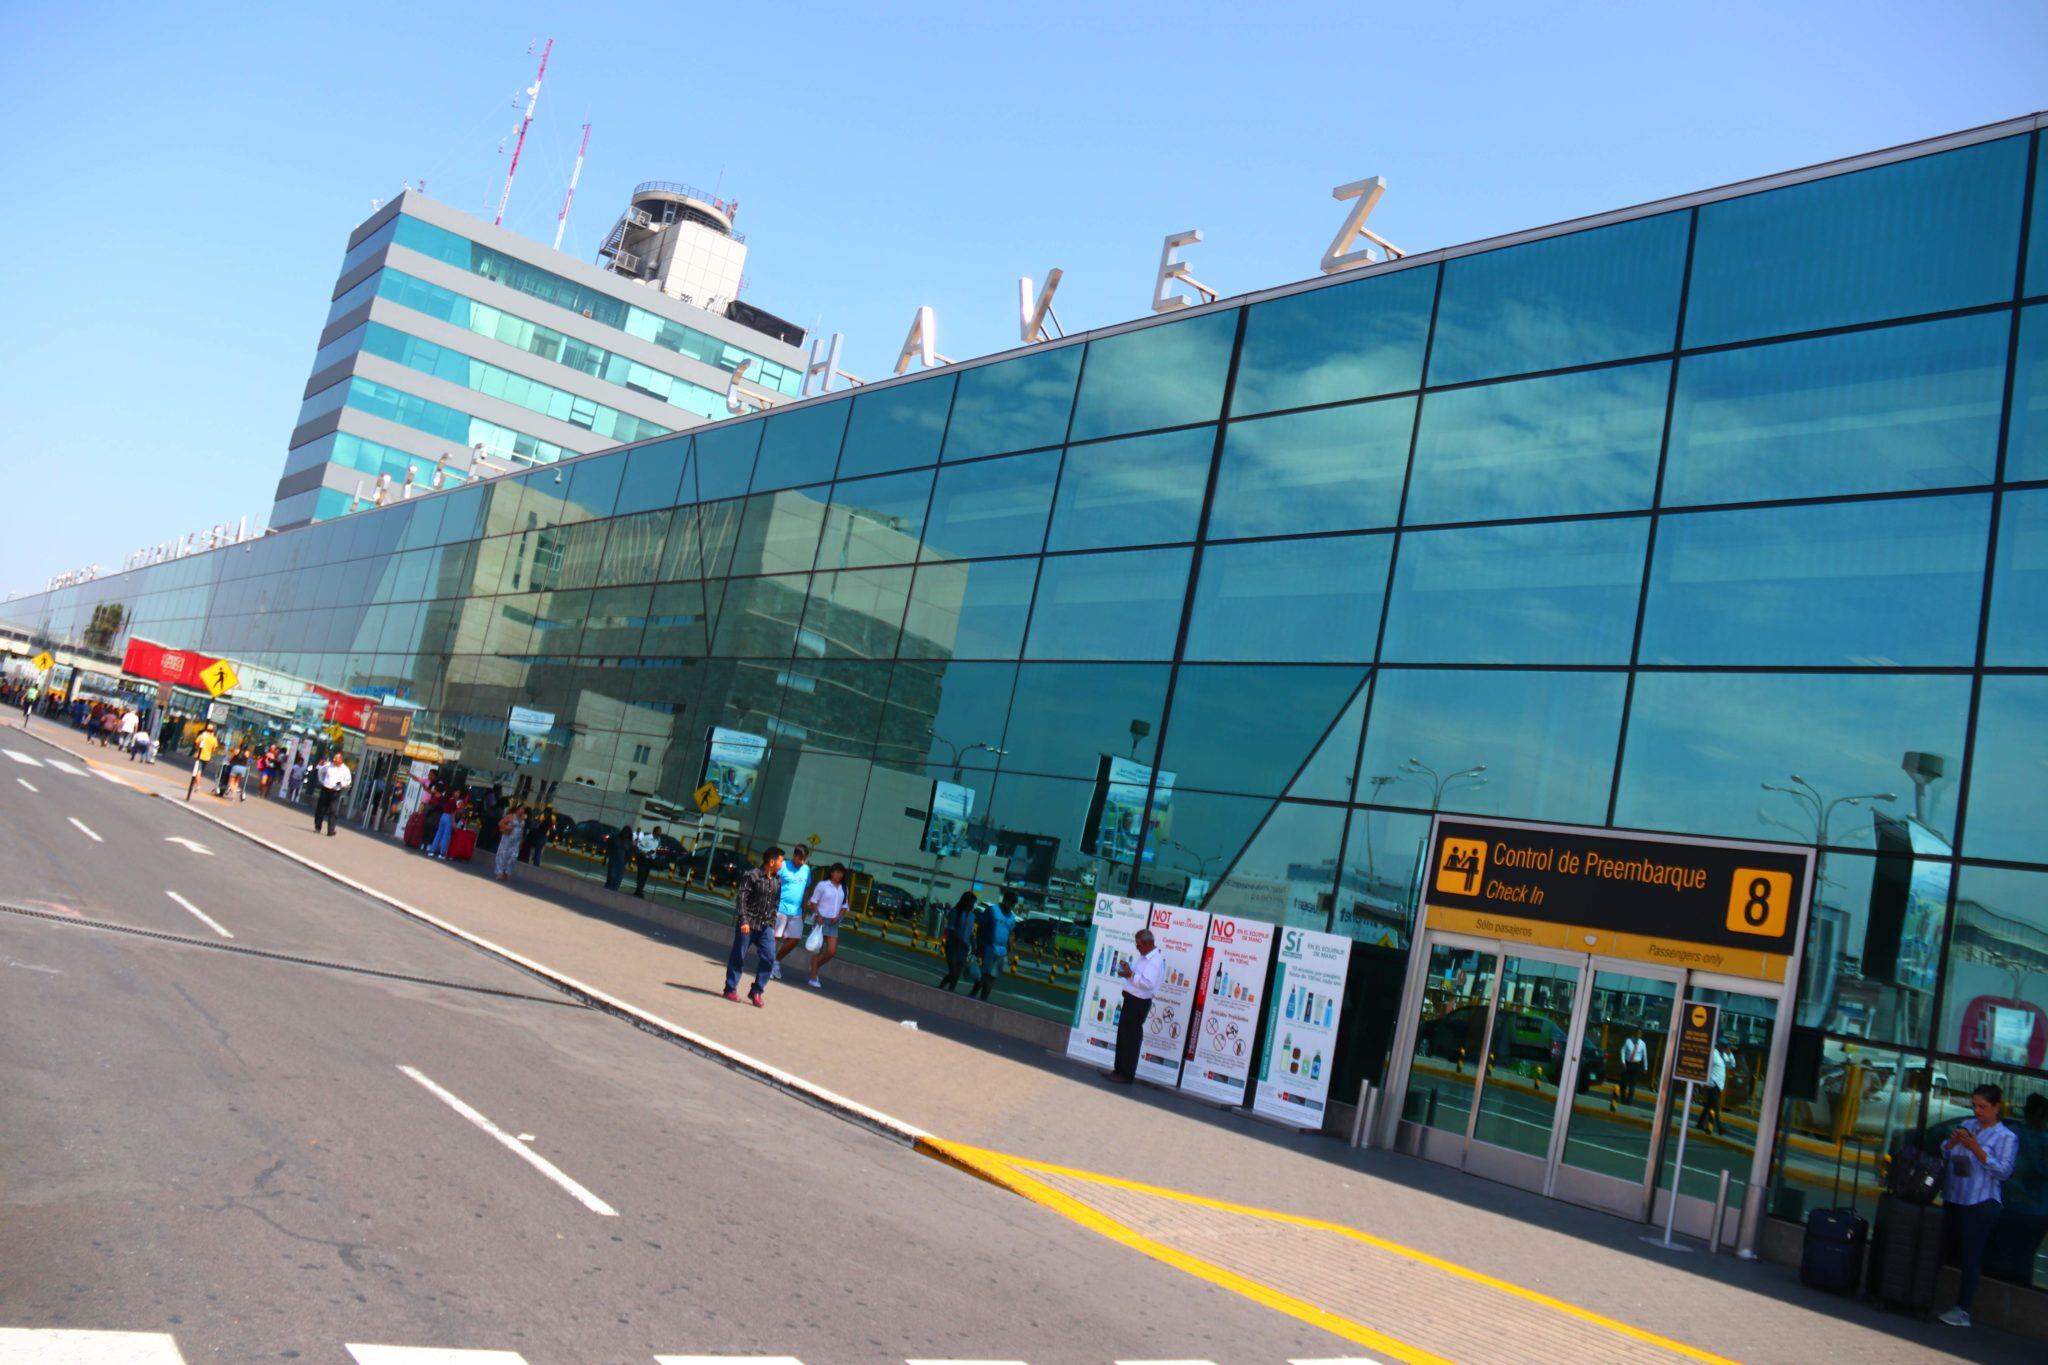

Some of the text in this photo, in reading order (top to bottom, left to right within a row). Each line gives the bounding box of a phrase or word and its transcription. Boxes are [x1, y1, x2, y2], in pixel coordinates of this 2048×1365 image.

[726, 175, 1388, 415] CHAVEZ
[1493, 842, 1707, 892] Control de Preembarque
[1486, 880, 1545, 905] Check In
[1743, 877, 1770, 927] 8
[1098, 899, 1114, 912] OK
[1153, 909, 1172, 923] NOT
[1212, 919, 1235, 938] NO
[1494, 923, 1533, 938] pasajeros
[1649, 943, 1725, 967] Passengers only
